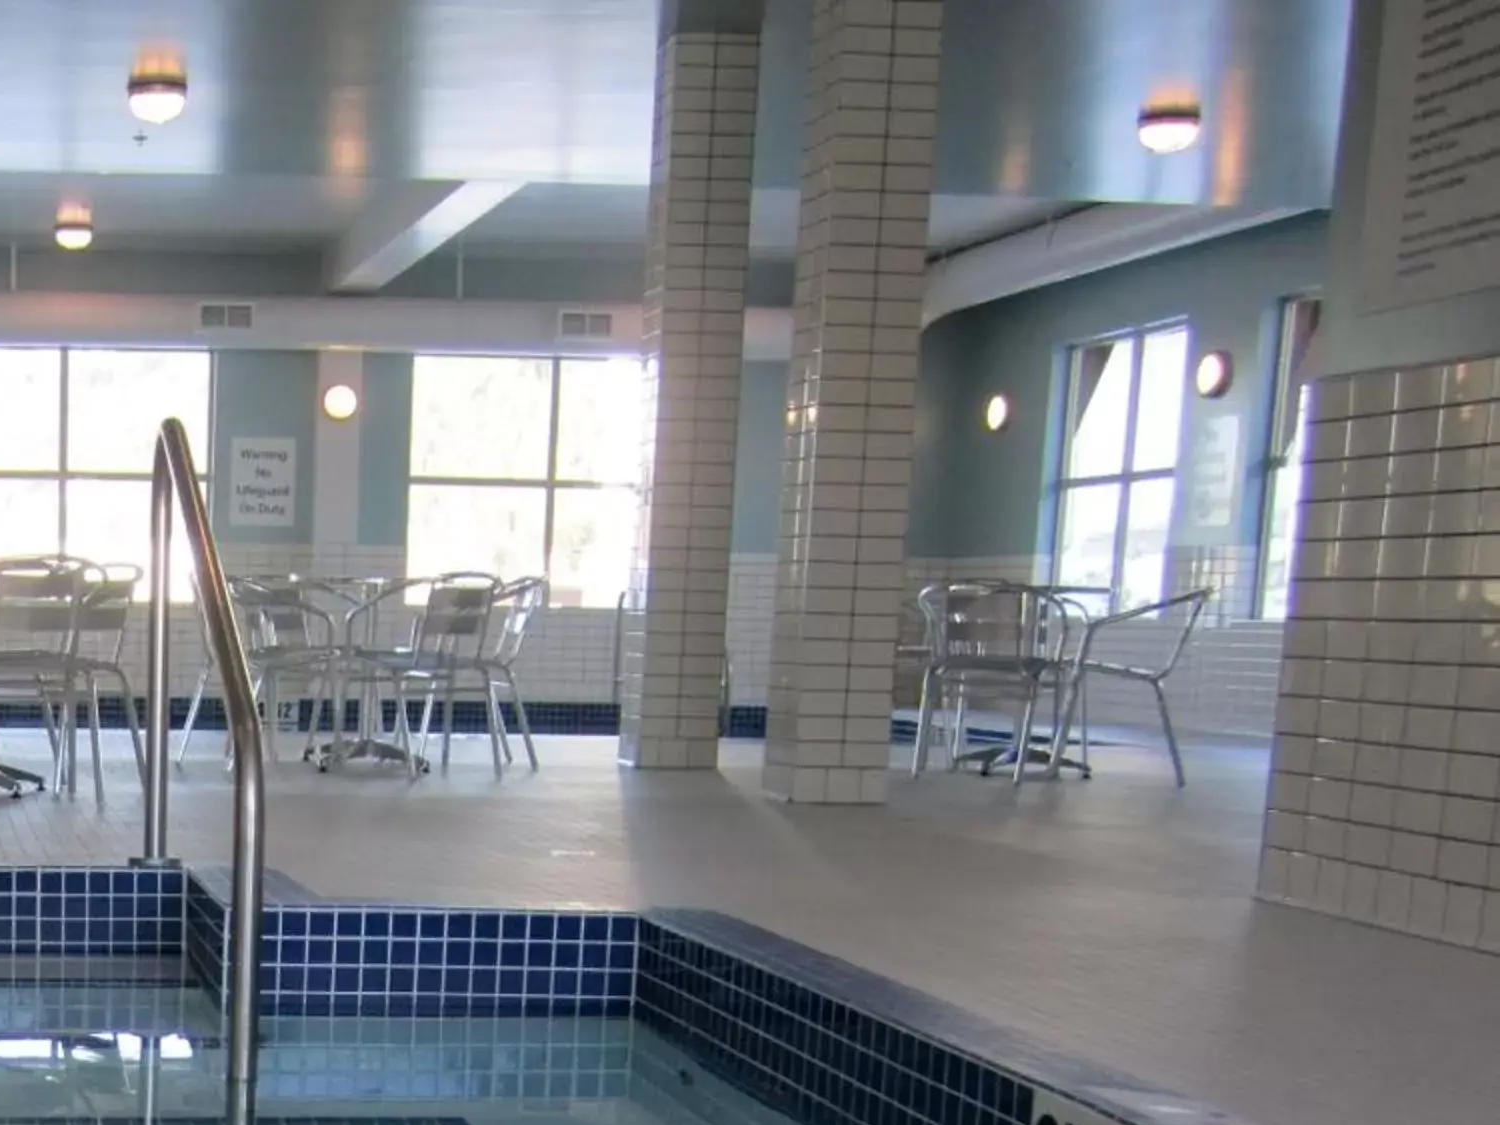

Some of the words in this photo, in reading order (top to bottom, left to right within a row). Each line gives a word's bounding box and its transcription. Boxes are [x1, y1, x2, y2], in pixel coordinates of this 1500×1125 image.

[241, 448, 288, 463] Warning
[236, 484, 289, 499] Lifeguard
[258, 502, 285, 517] Duty
